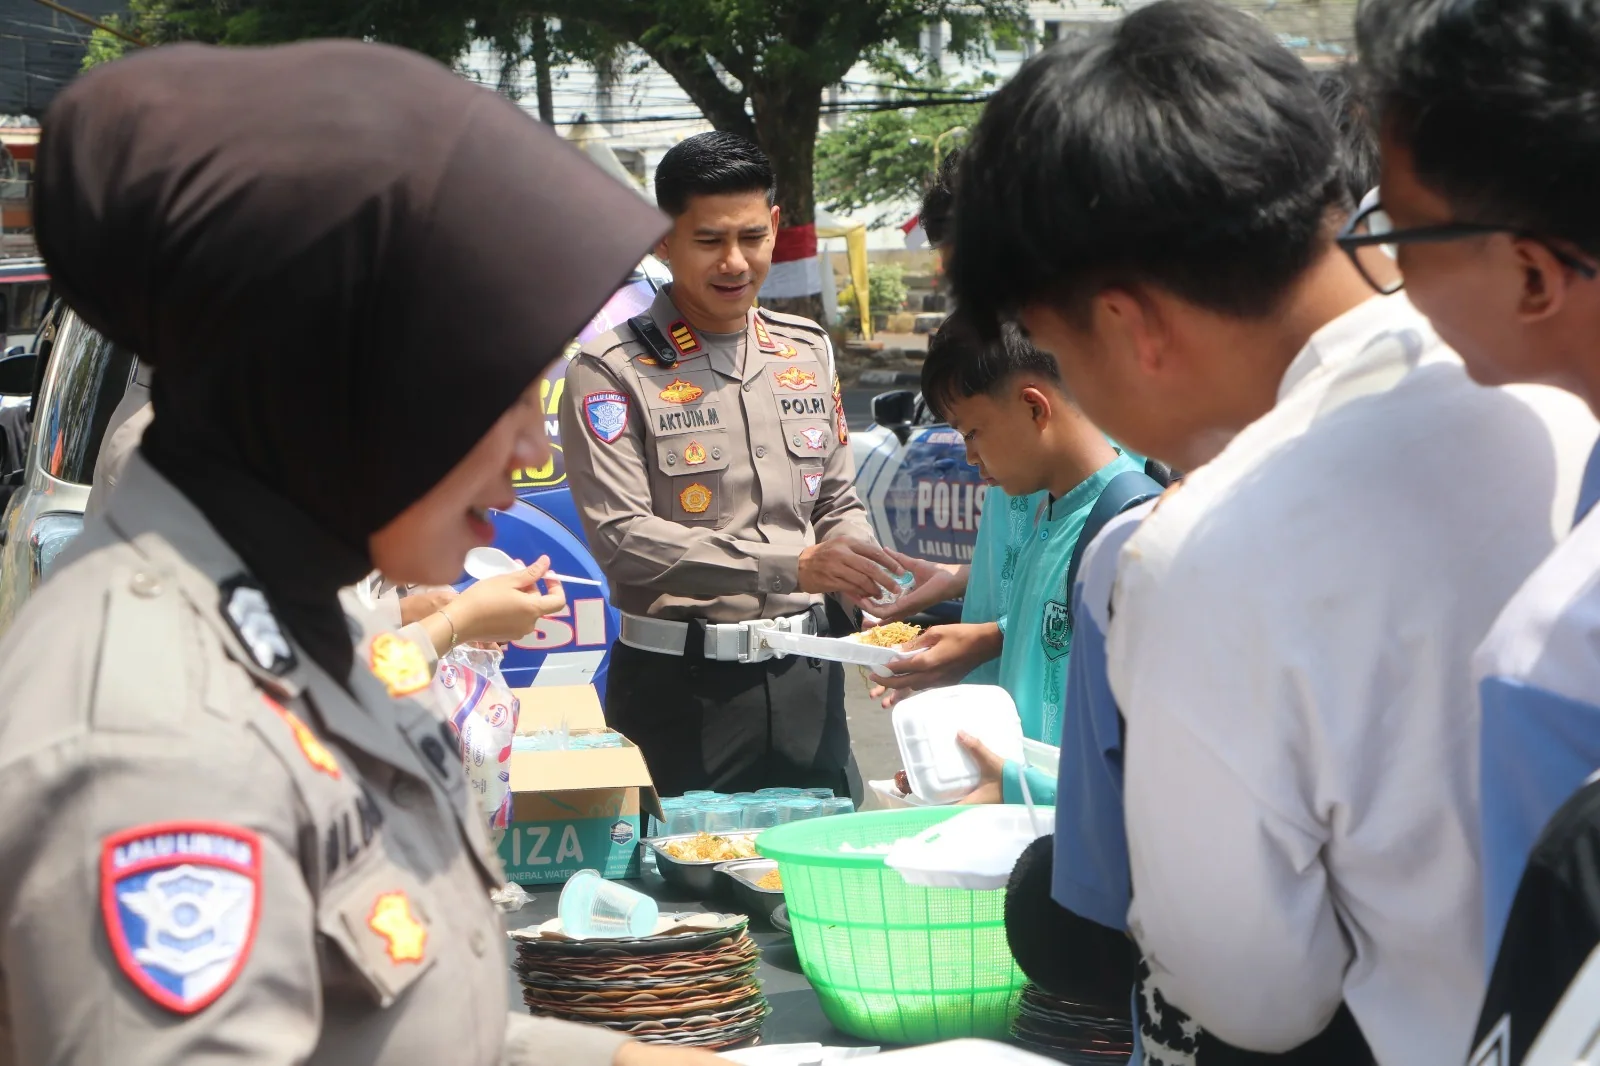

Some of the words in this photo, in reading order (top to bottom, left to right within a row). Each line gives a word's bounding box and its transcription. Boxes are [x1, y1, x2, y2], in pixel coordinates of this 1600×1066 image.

[588, 394, 604, 402] LALU
[606, 393, 626, 402] LINTAS
[780, 398, 825, 415] POLRI
[659, 407, 720, 431] AKTUIN.M
[919, 540, 952, 557] LALU
[445, 668, 456, 686] HIBA
[491, 706, 504, 725] HIBA
